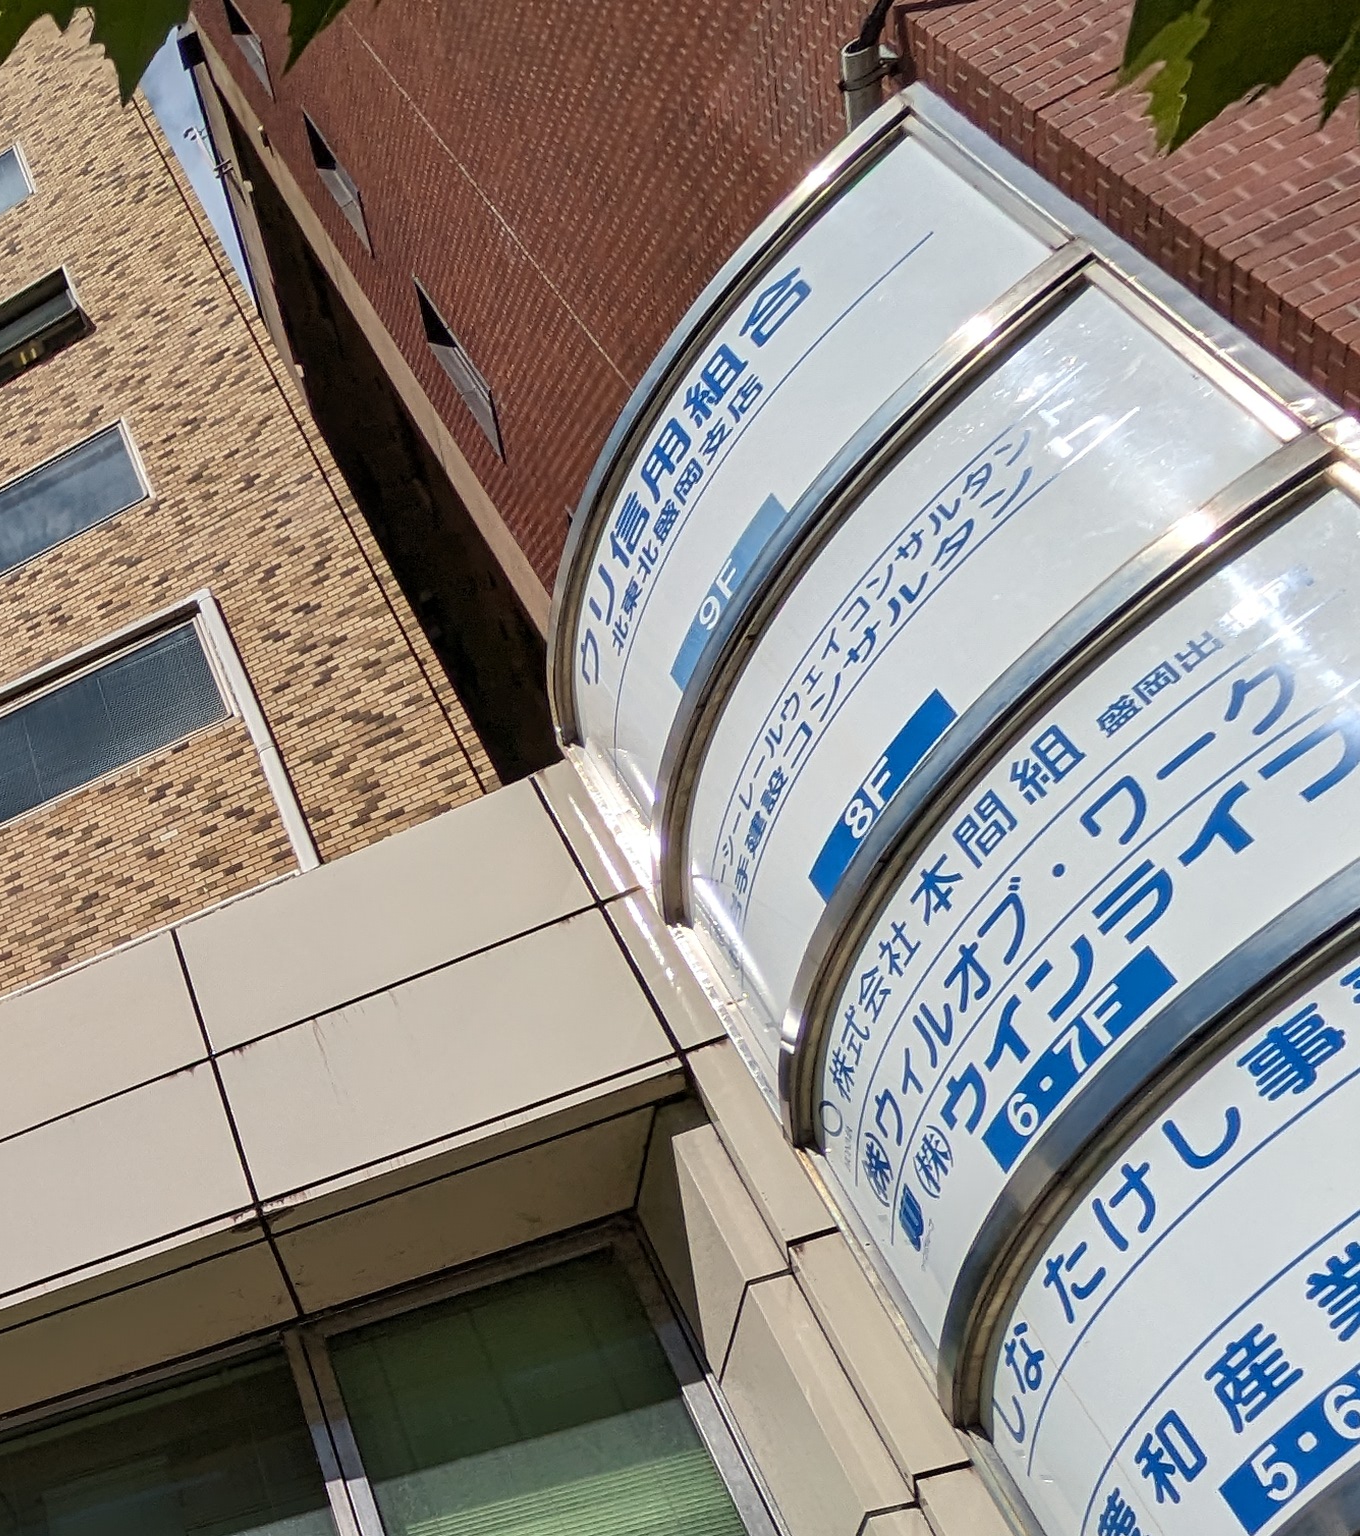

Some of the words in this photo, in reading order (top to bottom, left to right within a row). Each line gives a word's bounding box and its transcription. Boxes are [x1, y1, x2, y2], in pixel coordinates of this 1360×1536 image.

[582, 266, 813, 686] ウリ信用組合
[612, 373, 764, 656] 北東北盛岡支店
[697, 557, 737, 631] 9F
[829, 724, 1087, 1103] 株式会社本間組
[844, 755, 892, 840] 8F
[992, 962, 1360, 1443] しなたけし事
